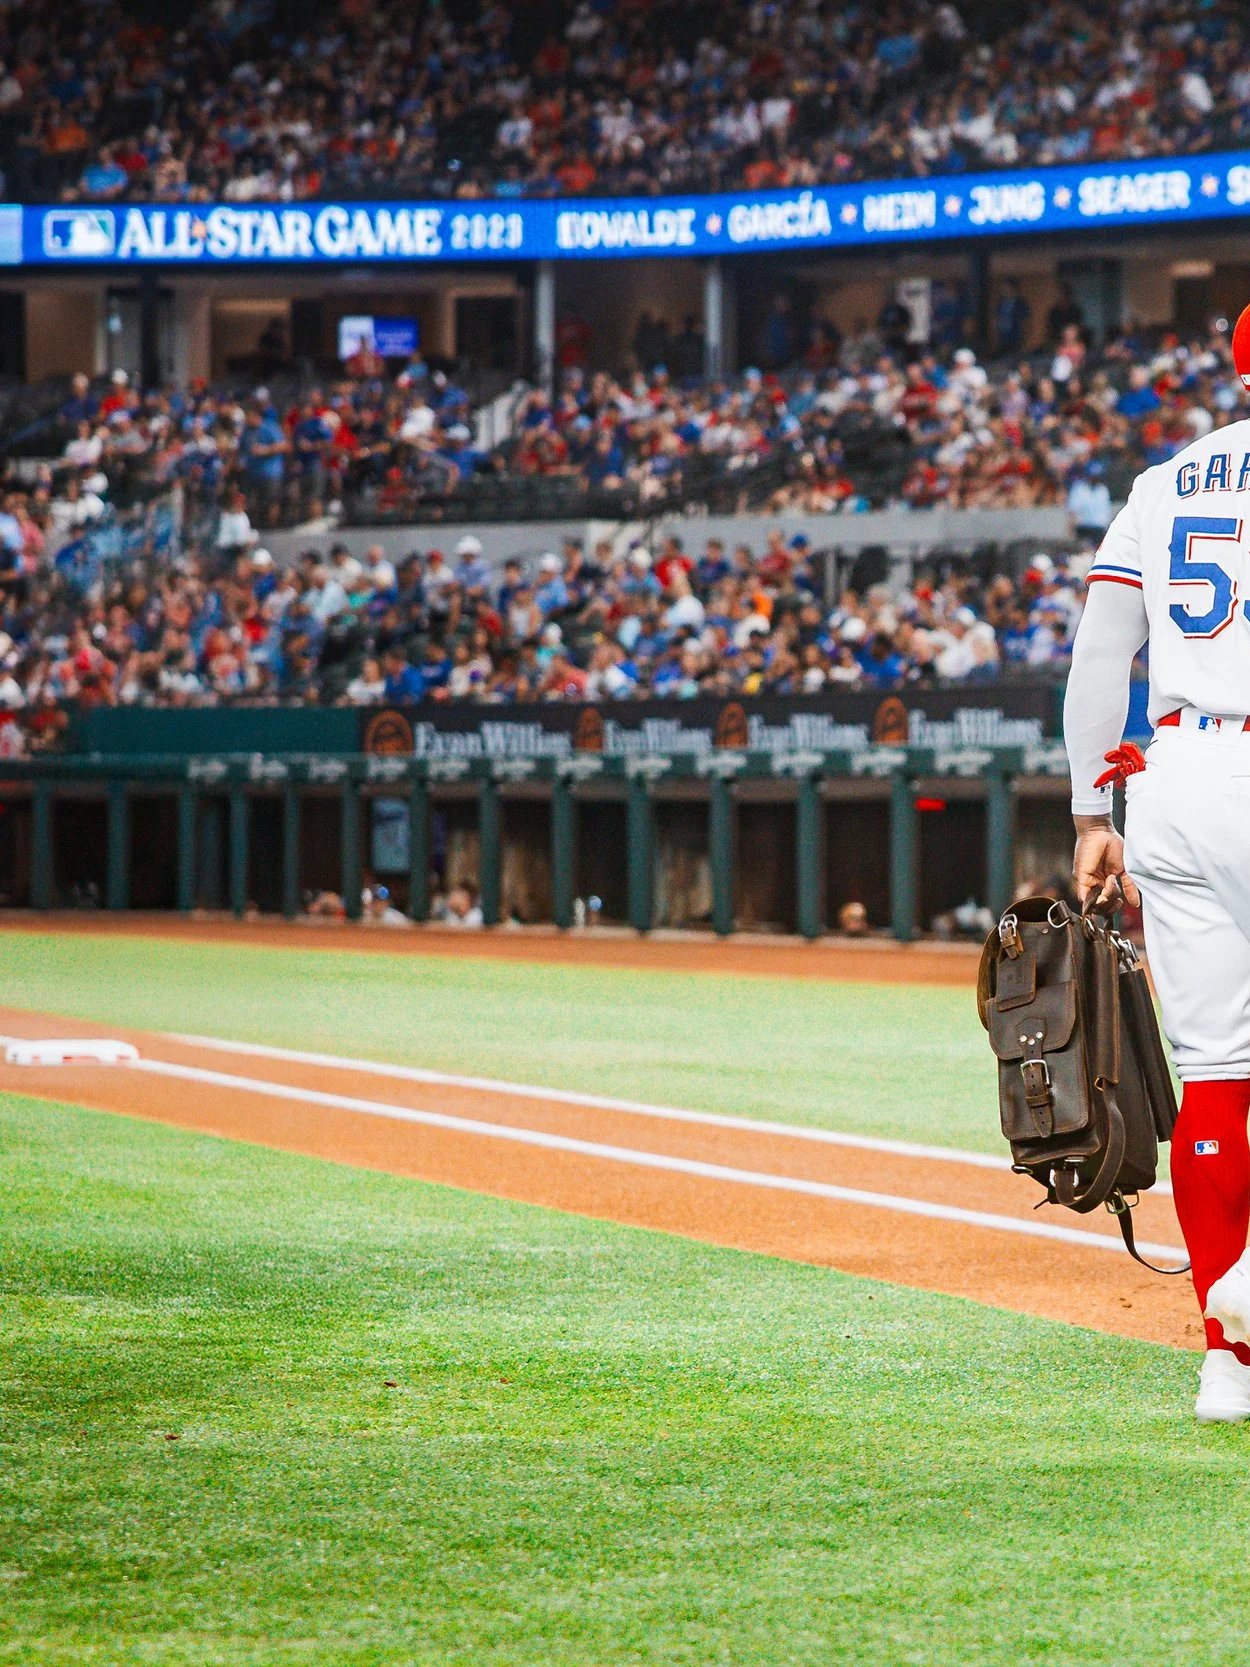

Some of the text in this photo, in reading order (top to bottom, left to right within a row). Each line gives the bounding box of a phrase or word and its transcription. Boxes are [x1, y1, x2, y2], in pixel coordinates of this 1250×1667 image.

[967, 181, 1046, 225] JUNG
[1077, 170, 1191, 217] SEAGER
[205, 206, 315, 258] STAR
[313, 204, 443, 257] GAME
[450, 212, 524, 250] 2023
